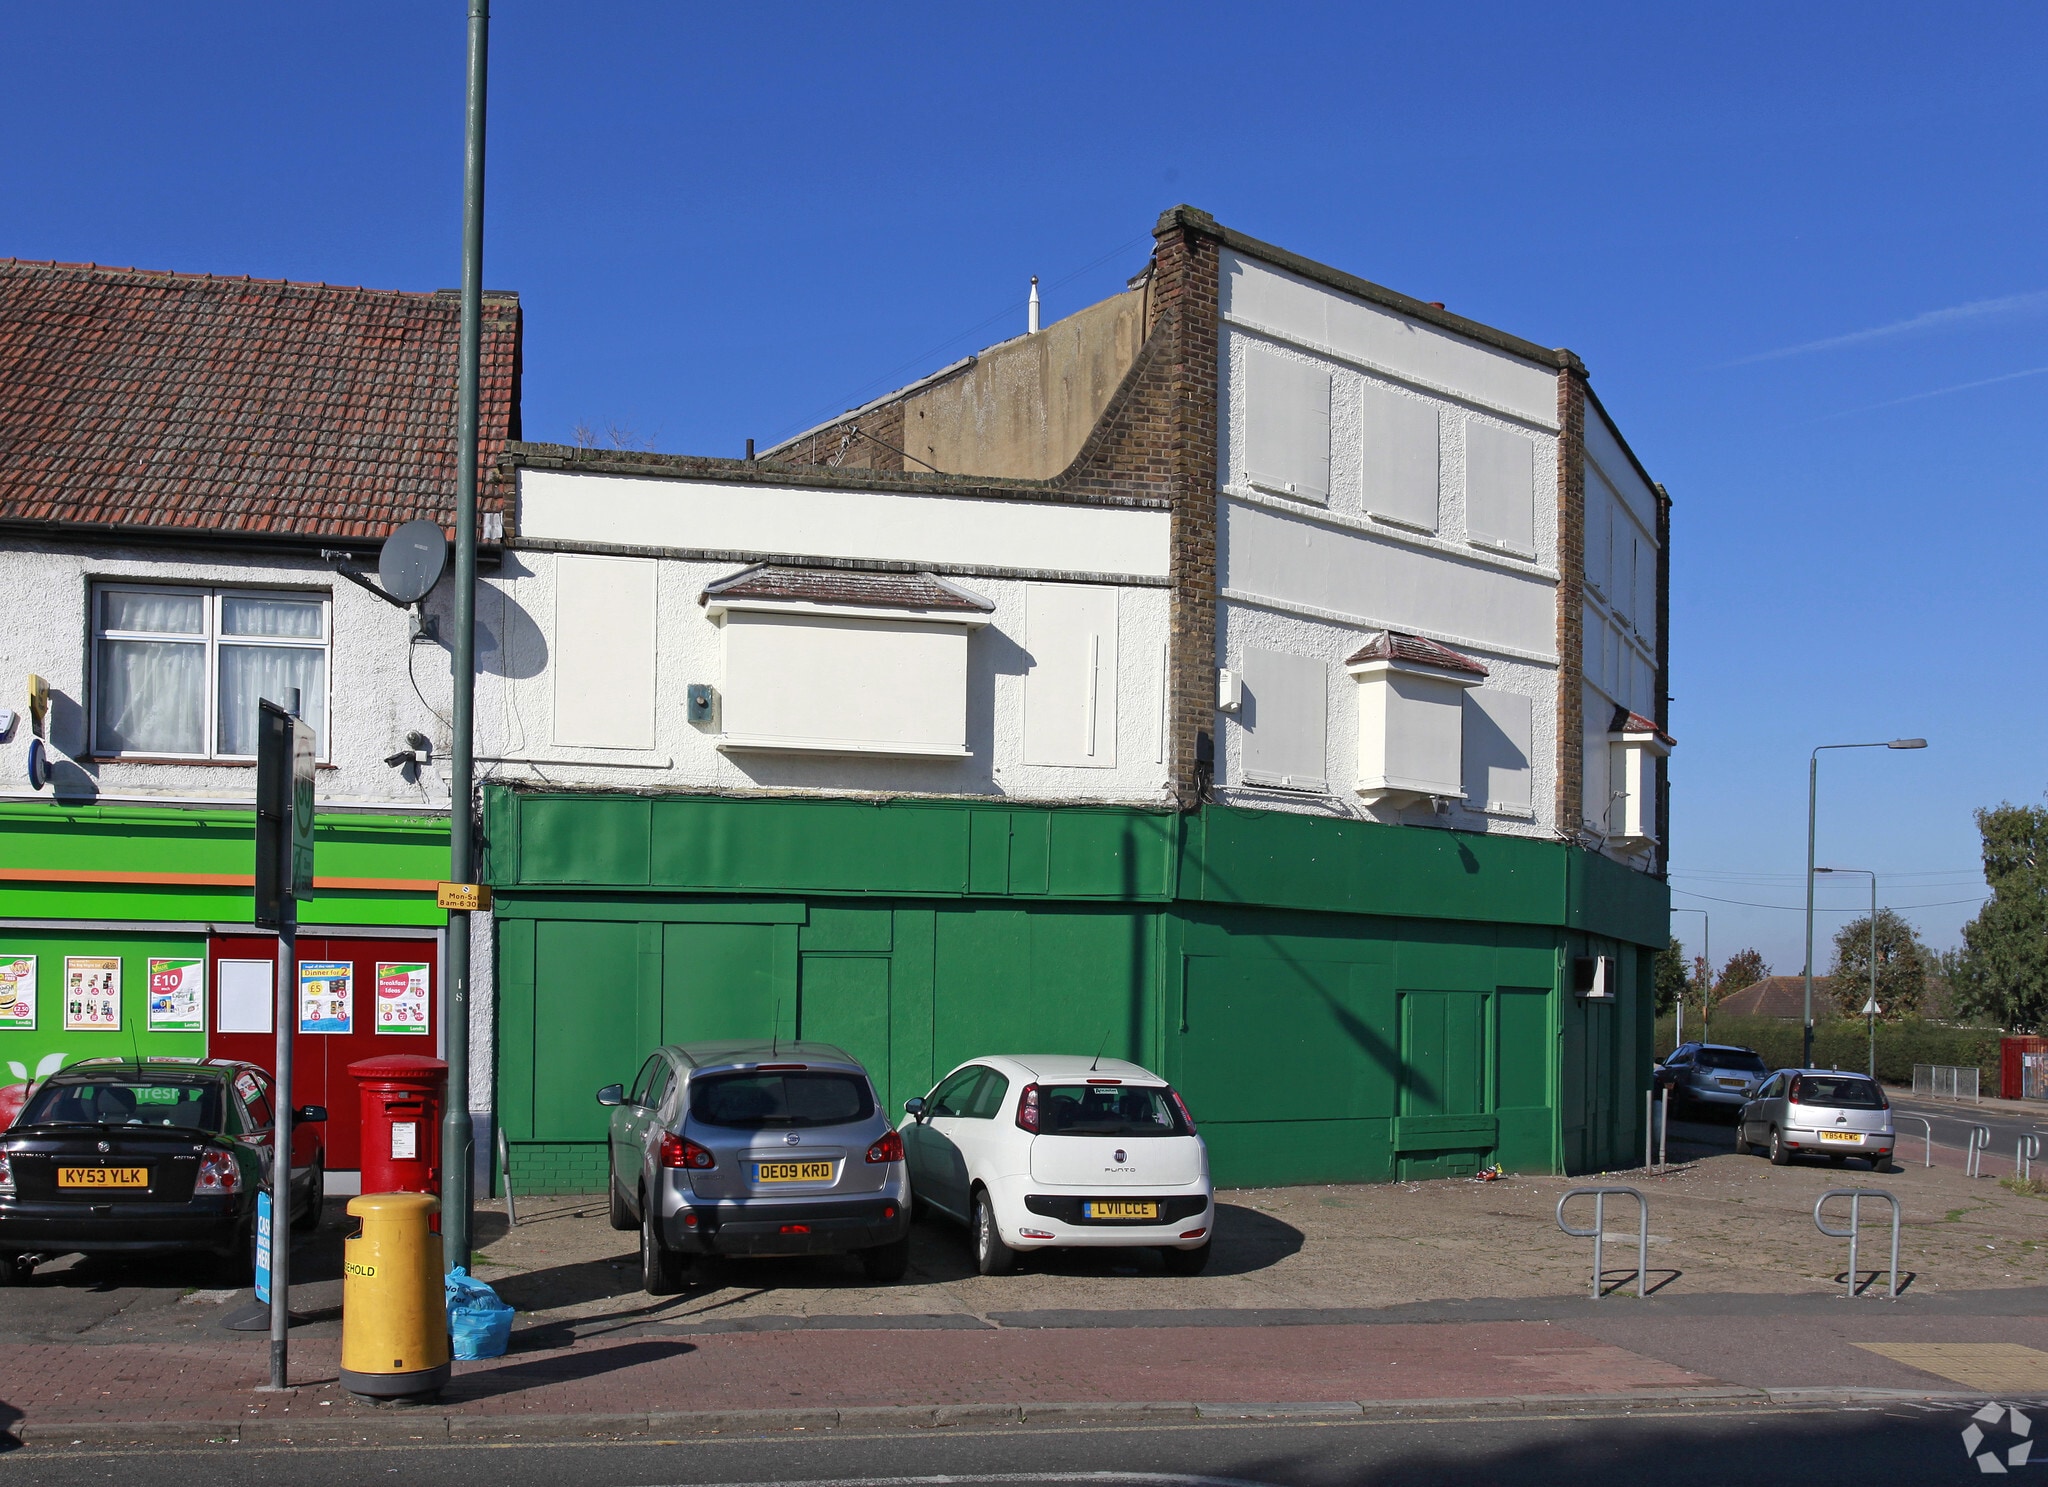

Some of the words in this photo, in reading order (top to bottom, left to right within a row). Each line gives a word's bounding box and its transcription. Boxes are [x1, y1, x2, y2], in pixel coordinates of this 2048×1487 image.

[298, 768, 310, 808] 30
[341, 967, 348, 977] 2
[153, 974, 178, 986] £10
[310, 985, 321, 993] £5
[66, 1169, 106, 1183] KY53
[112, 1169, 140, 1183] YLK
[761, 1165, 798, 1179] OE09
[802, 1164, 829, 1177] KRD
[1125, 1203, 1149, 1215] CCE
[344, 1262, 375, 1277] EHOLD
